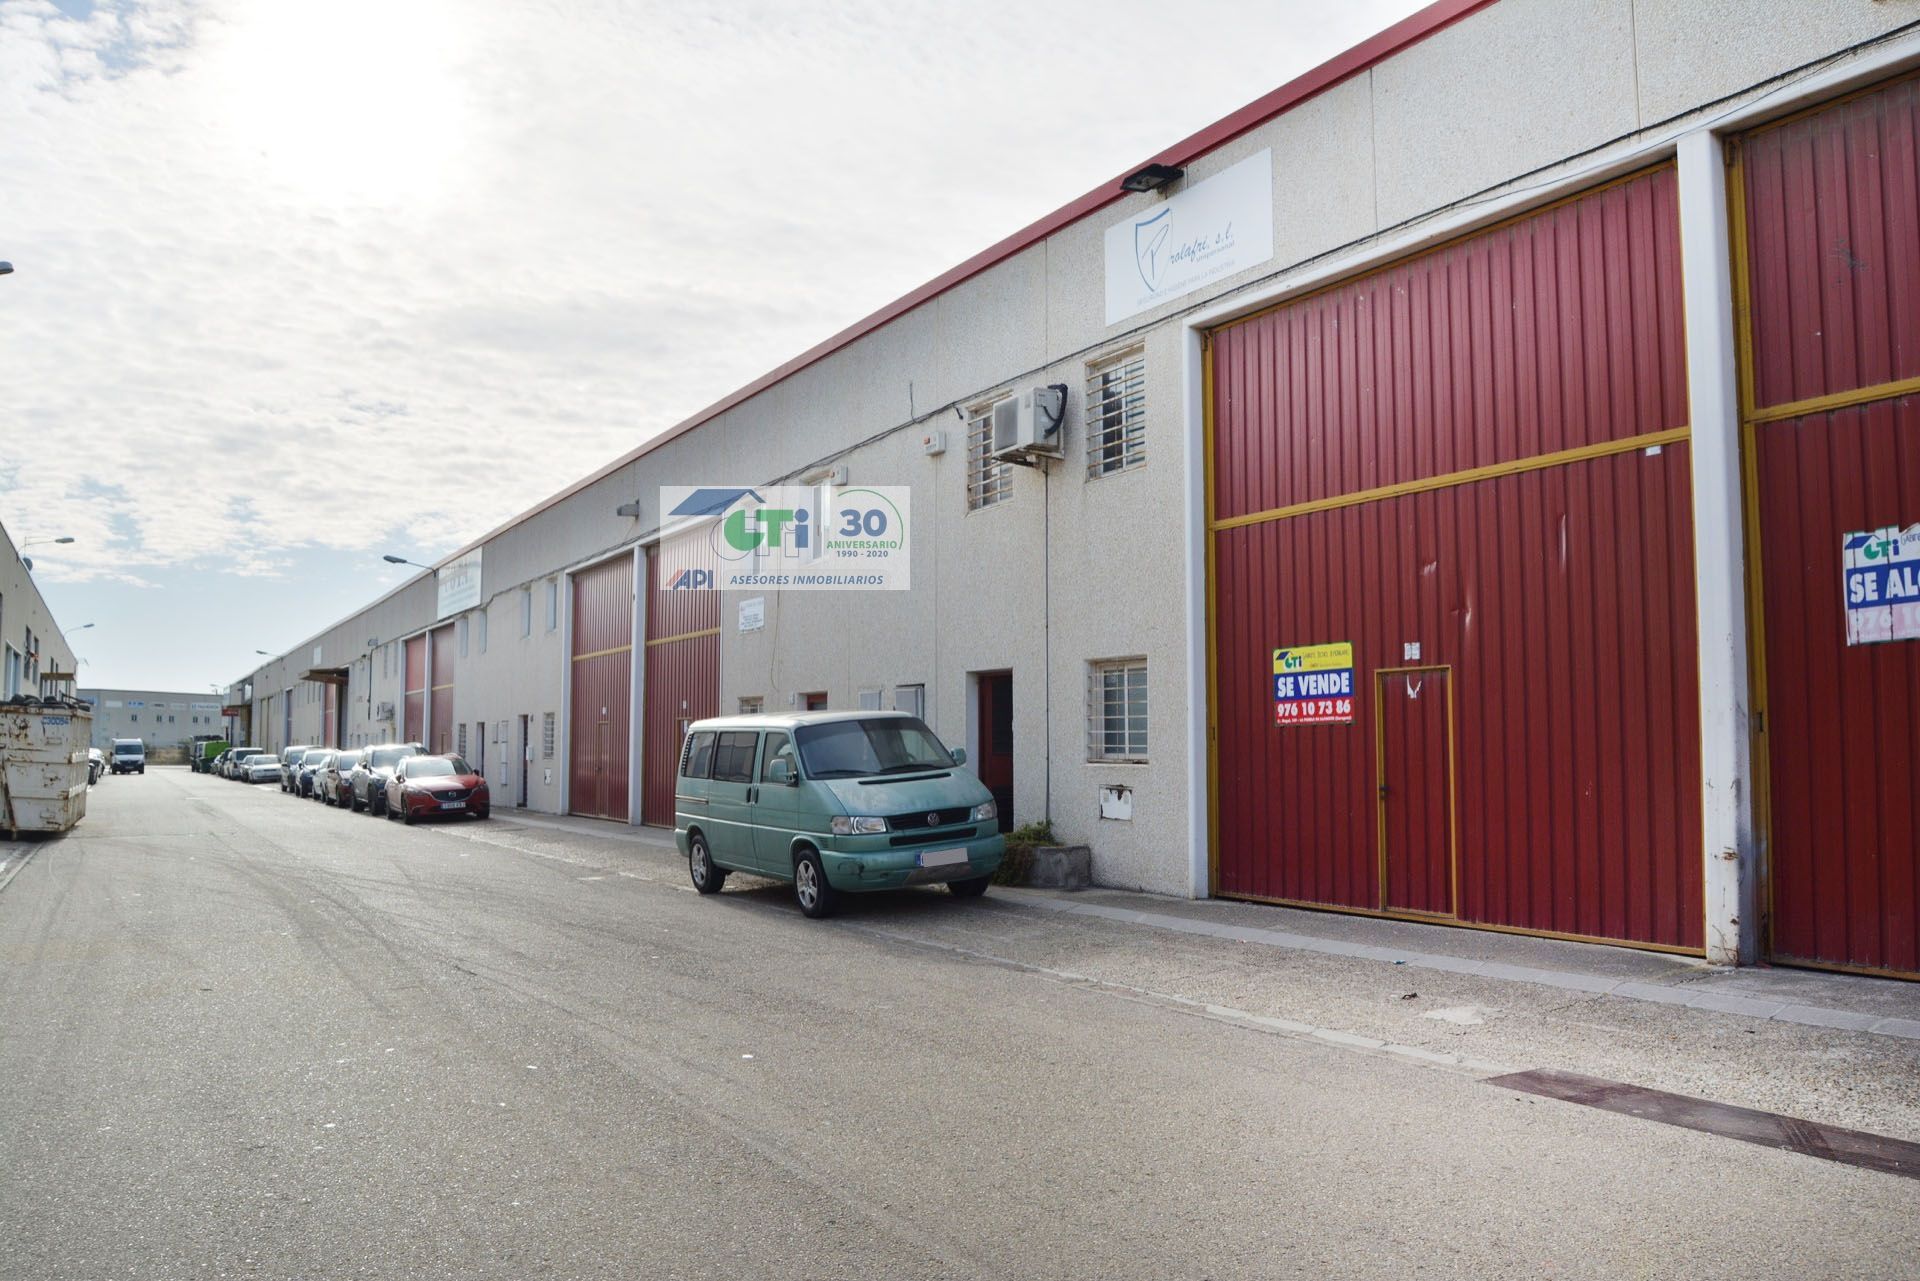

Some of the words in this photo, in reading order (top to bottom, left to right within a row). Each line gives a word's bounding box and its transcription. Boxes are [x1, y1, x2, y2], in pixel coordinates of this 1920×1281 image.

[1849, 571, 1878, 604] SE
[1277, 677, 1295, 698] SE
[1297, 672, 1350, 696] VENDE
[1277, 703, 1298, 717] 976
[1301, 701, 1315, 716] 10
[1318, 701, 1333, 715] 73
